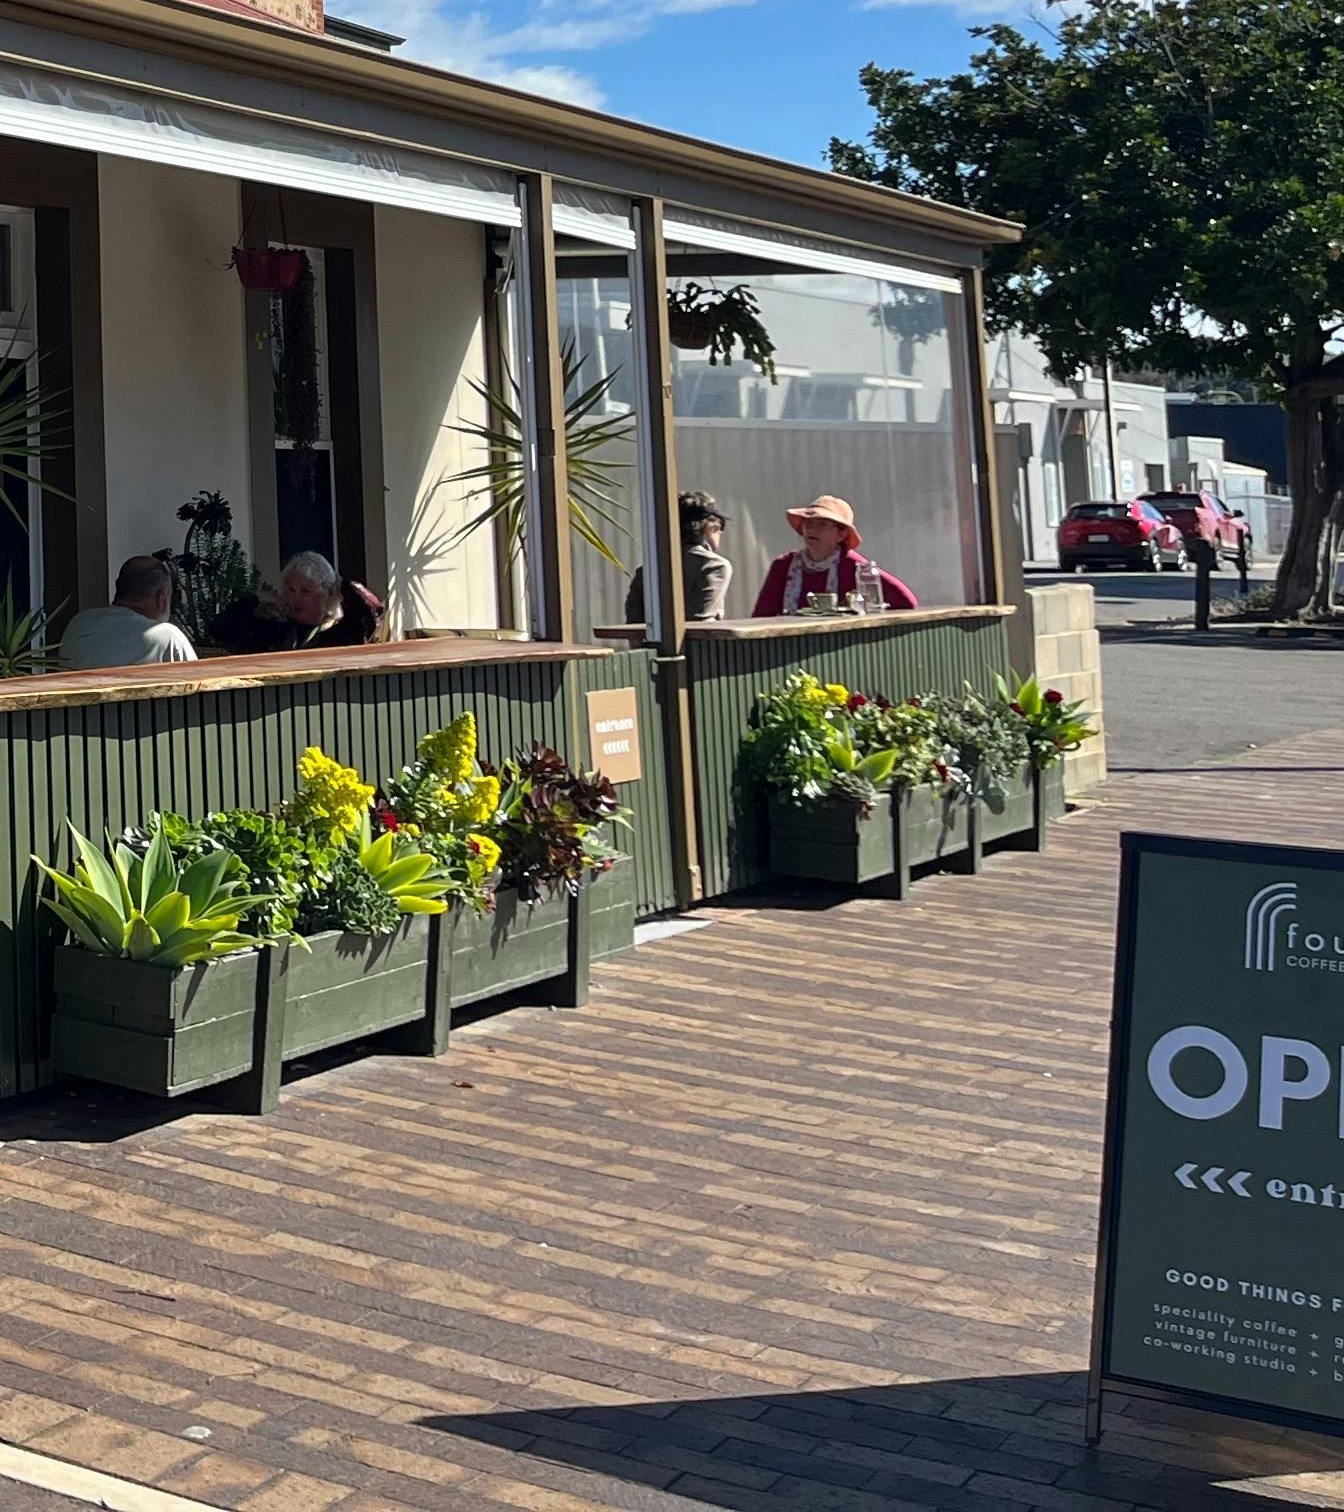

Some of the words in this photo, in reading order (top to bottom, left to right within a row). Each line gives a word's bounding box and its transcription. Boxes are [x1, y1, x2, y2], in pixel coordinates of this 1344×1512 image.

[1286, 955, 1344, 973] COFFEE
[1147, 1025, 1344, 1139] OP
[1166, 1269, 1230, 1292] GOOD
[1238, 1281, 1322, 1309] THINGS
[1153, 1303, 1235, 1328] speciality
[1243, 1319, 1298, 1338] coffee
[1155, 1320, 1216, 1341] vintage
[1223, 1331, 1297, 1355] furniture
[1143, 1336, 1236, 1364] co-working
[1243, 1353, 1297, 1373] studio
